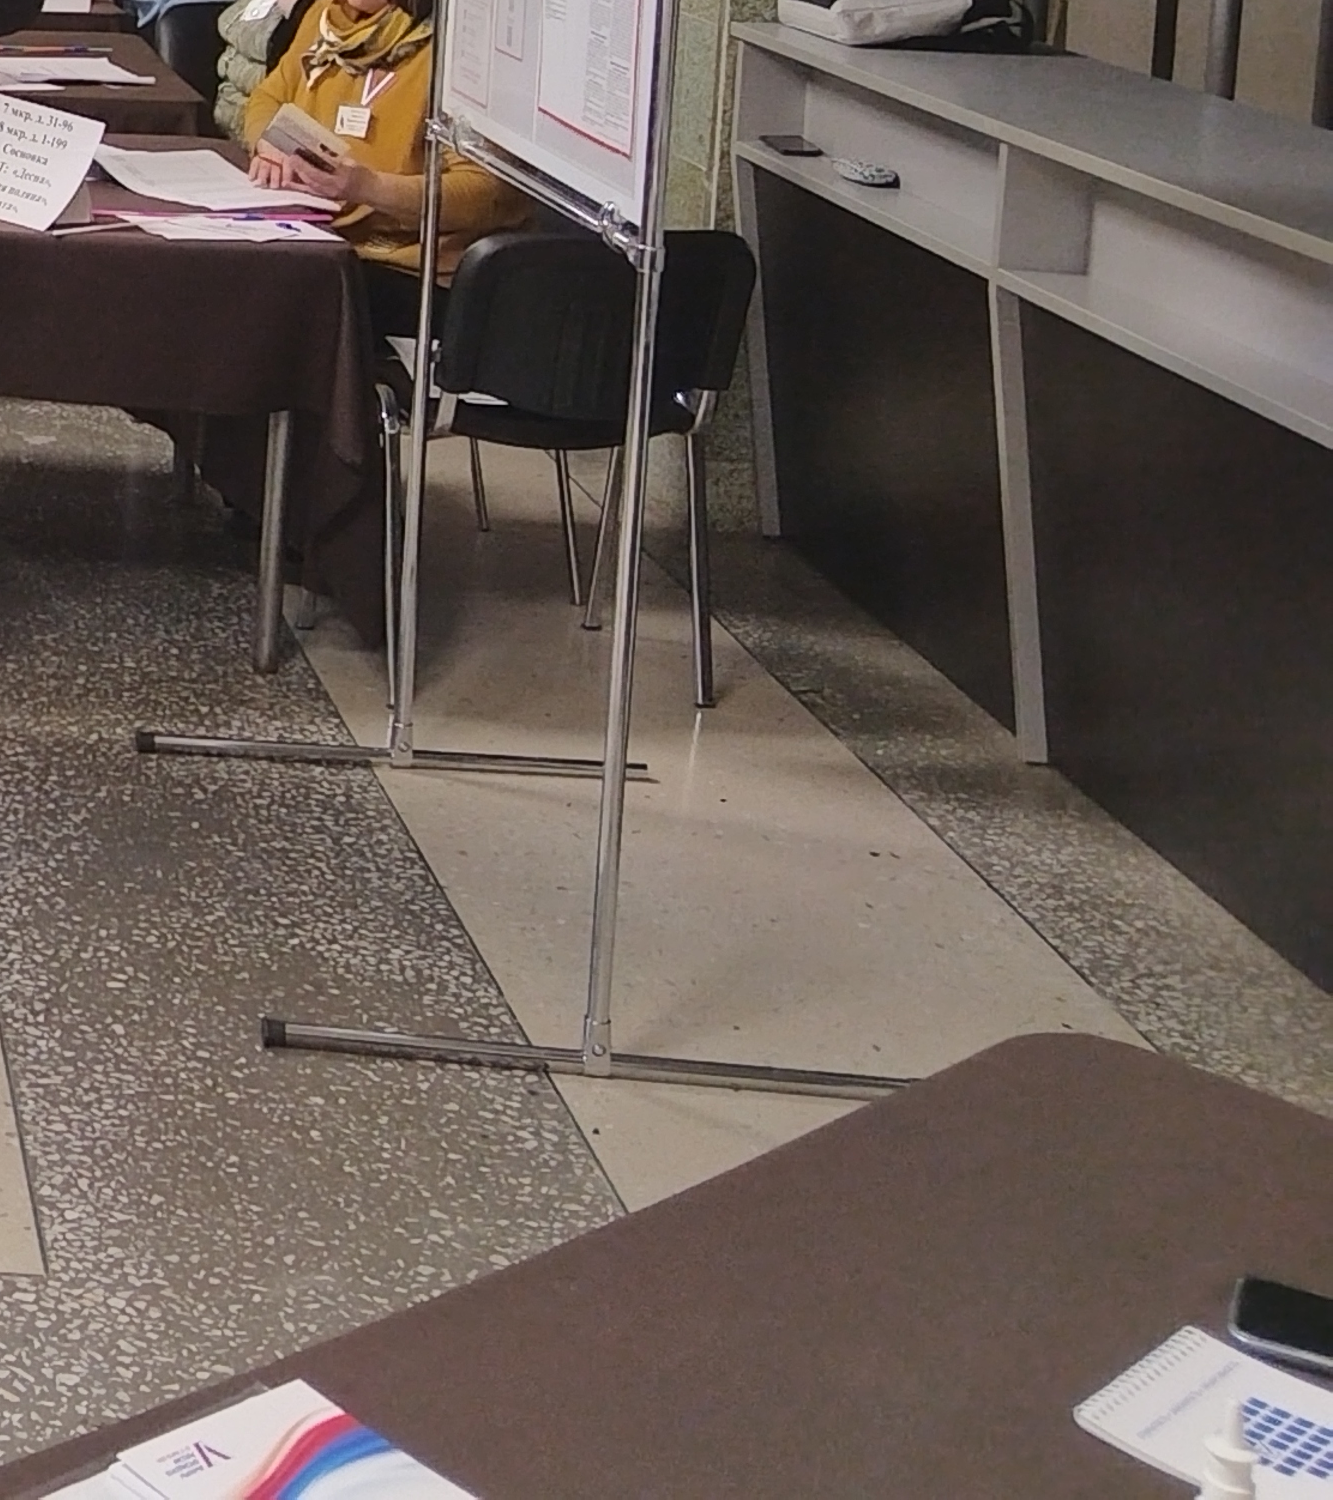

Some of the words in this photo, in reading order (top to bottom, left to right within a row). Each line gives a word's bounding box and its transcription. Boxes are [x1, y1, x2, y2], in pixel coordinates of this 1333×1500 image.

[3, 102, 9, 113] 7
[11, 108, 33, 123] мкр.
[46, 115, 74, 132] 31-96
[6, 126, 28, 141] мкр.
[41, 134, 68, 150] 1-199
[2, 143, 49, 166] Сосновка
